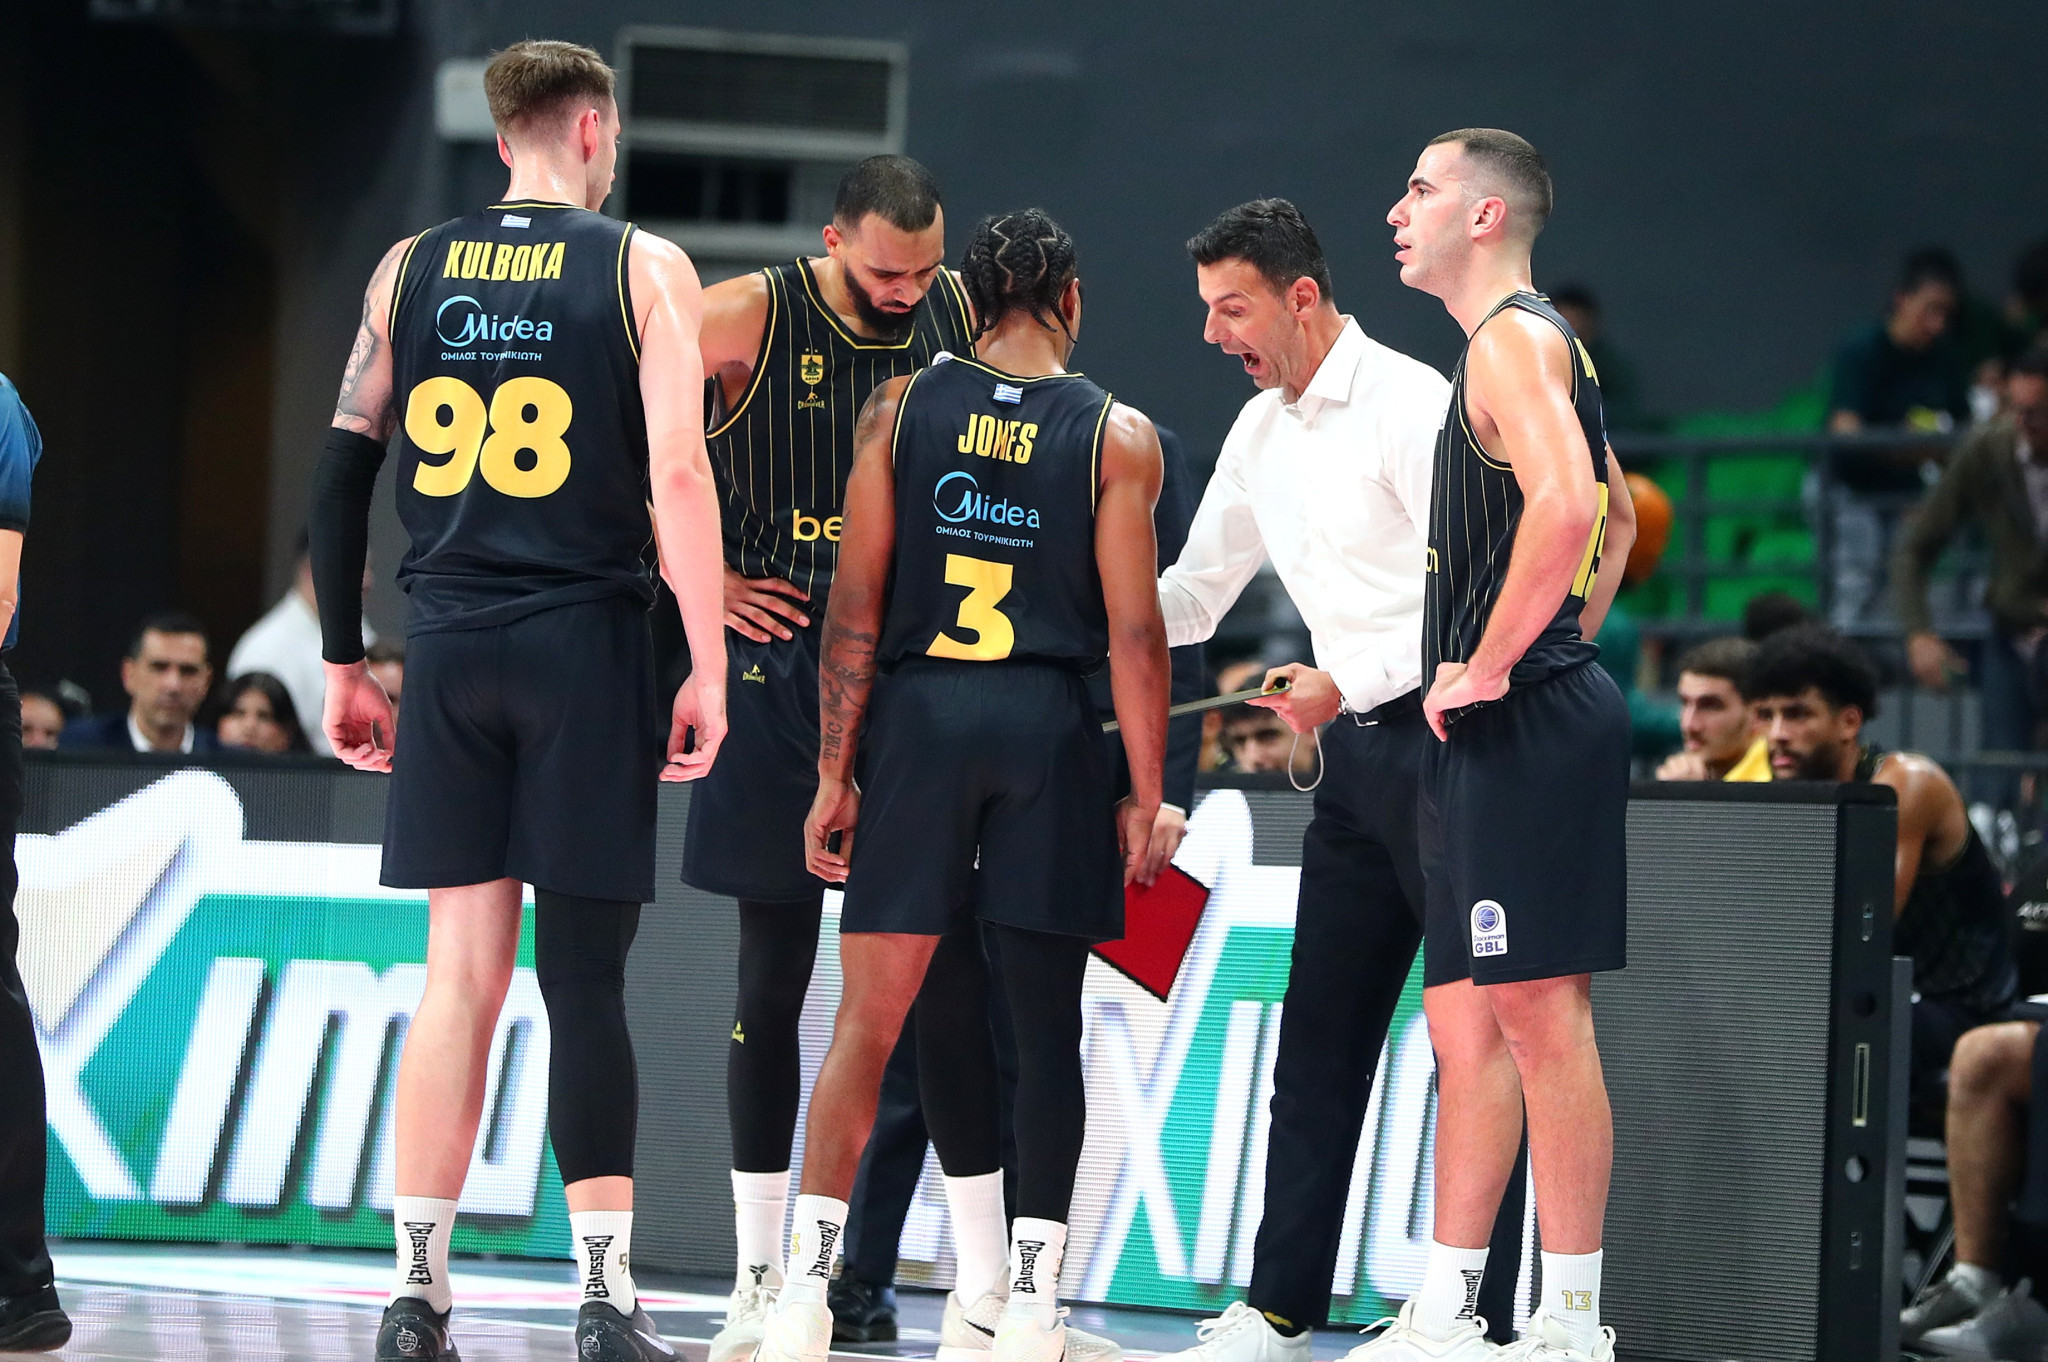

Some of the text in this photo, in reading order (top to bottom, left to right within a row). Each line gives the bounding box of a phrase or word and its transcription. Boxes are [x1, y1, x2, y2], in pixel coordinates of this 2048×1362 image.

[442, 240, 566, 282] KULBOKA
[435, 295, 554, 348] Midea
[440, 351, 477, 361] ΟΜΙΛΟΣ
[404, 376, 573, 499] 98
[957, 412, 1039, 465] JONES
[793, 508, 843, 542] be
[932, 470, 1041, 530] Midea
[935, 525, 1034, 549] ΟΜΙΛΟΣ ΤΟΥΡΝΙΚΙΩΤΗ
[925, 553, 1015, 662] 3
[1475, 941, 1504, 954] GBL
[403, 1221, 437, 1285] CROSSOVER
[582, 1235, 615, 1299] CROSSOVER
[806, 1219, 841, 1280] CROSSOVER
[1011, 1239, 1046, 1294] CROSSOVER
[1562, 1290, 1592, 1311] 13
